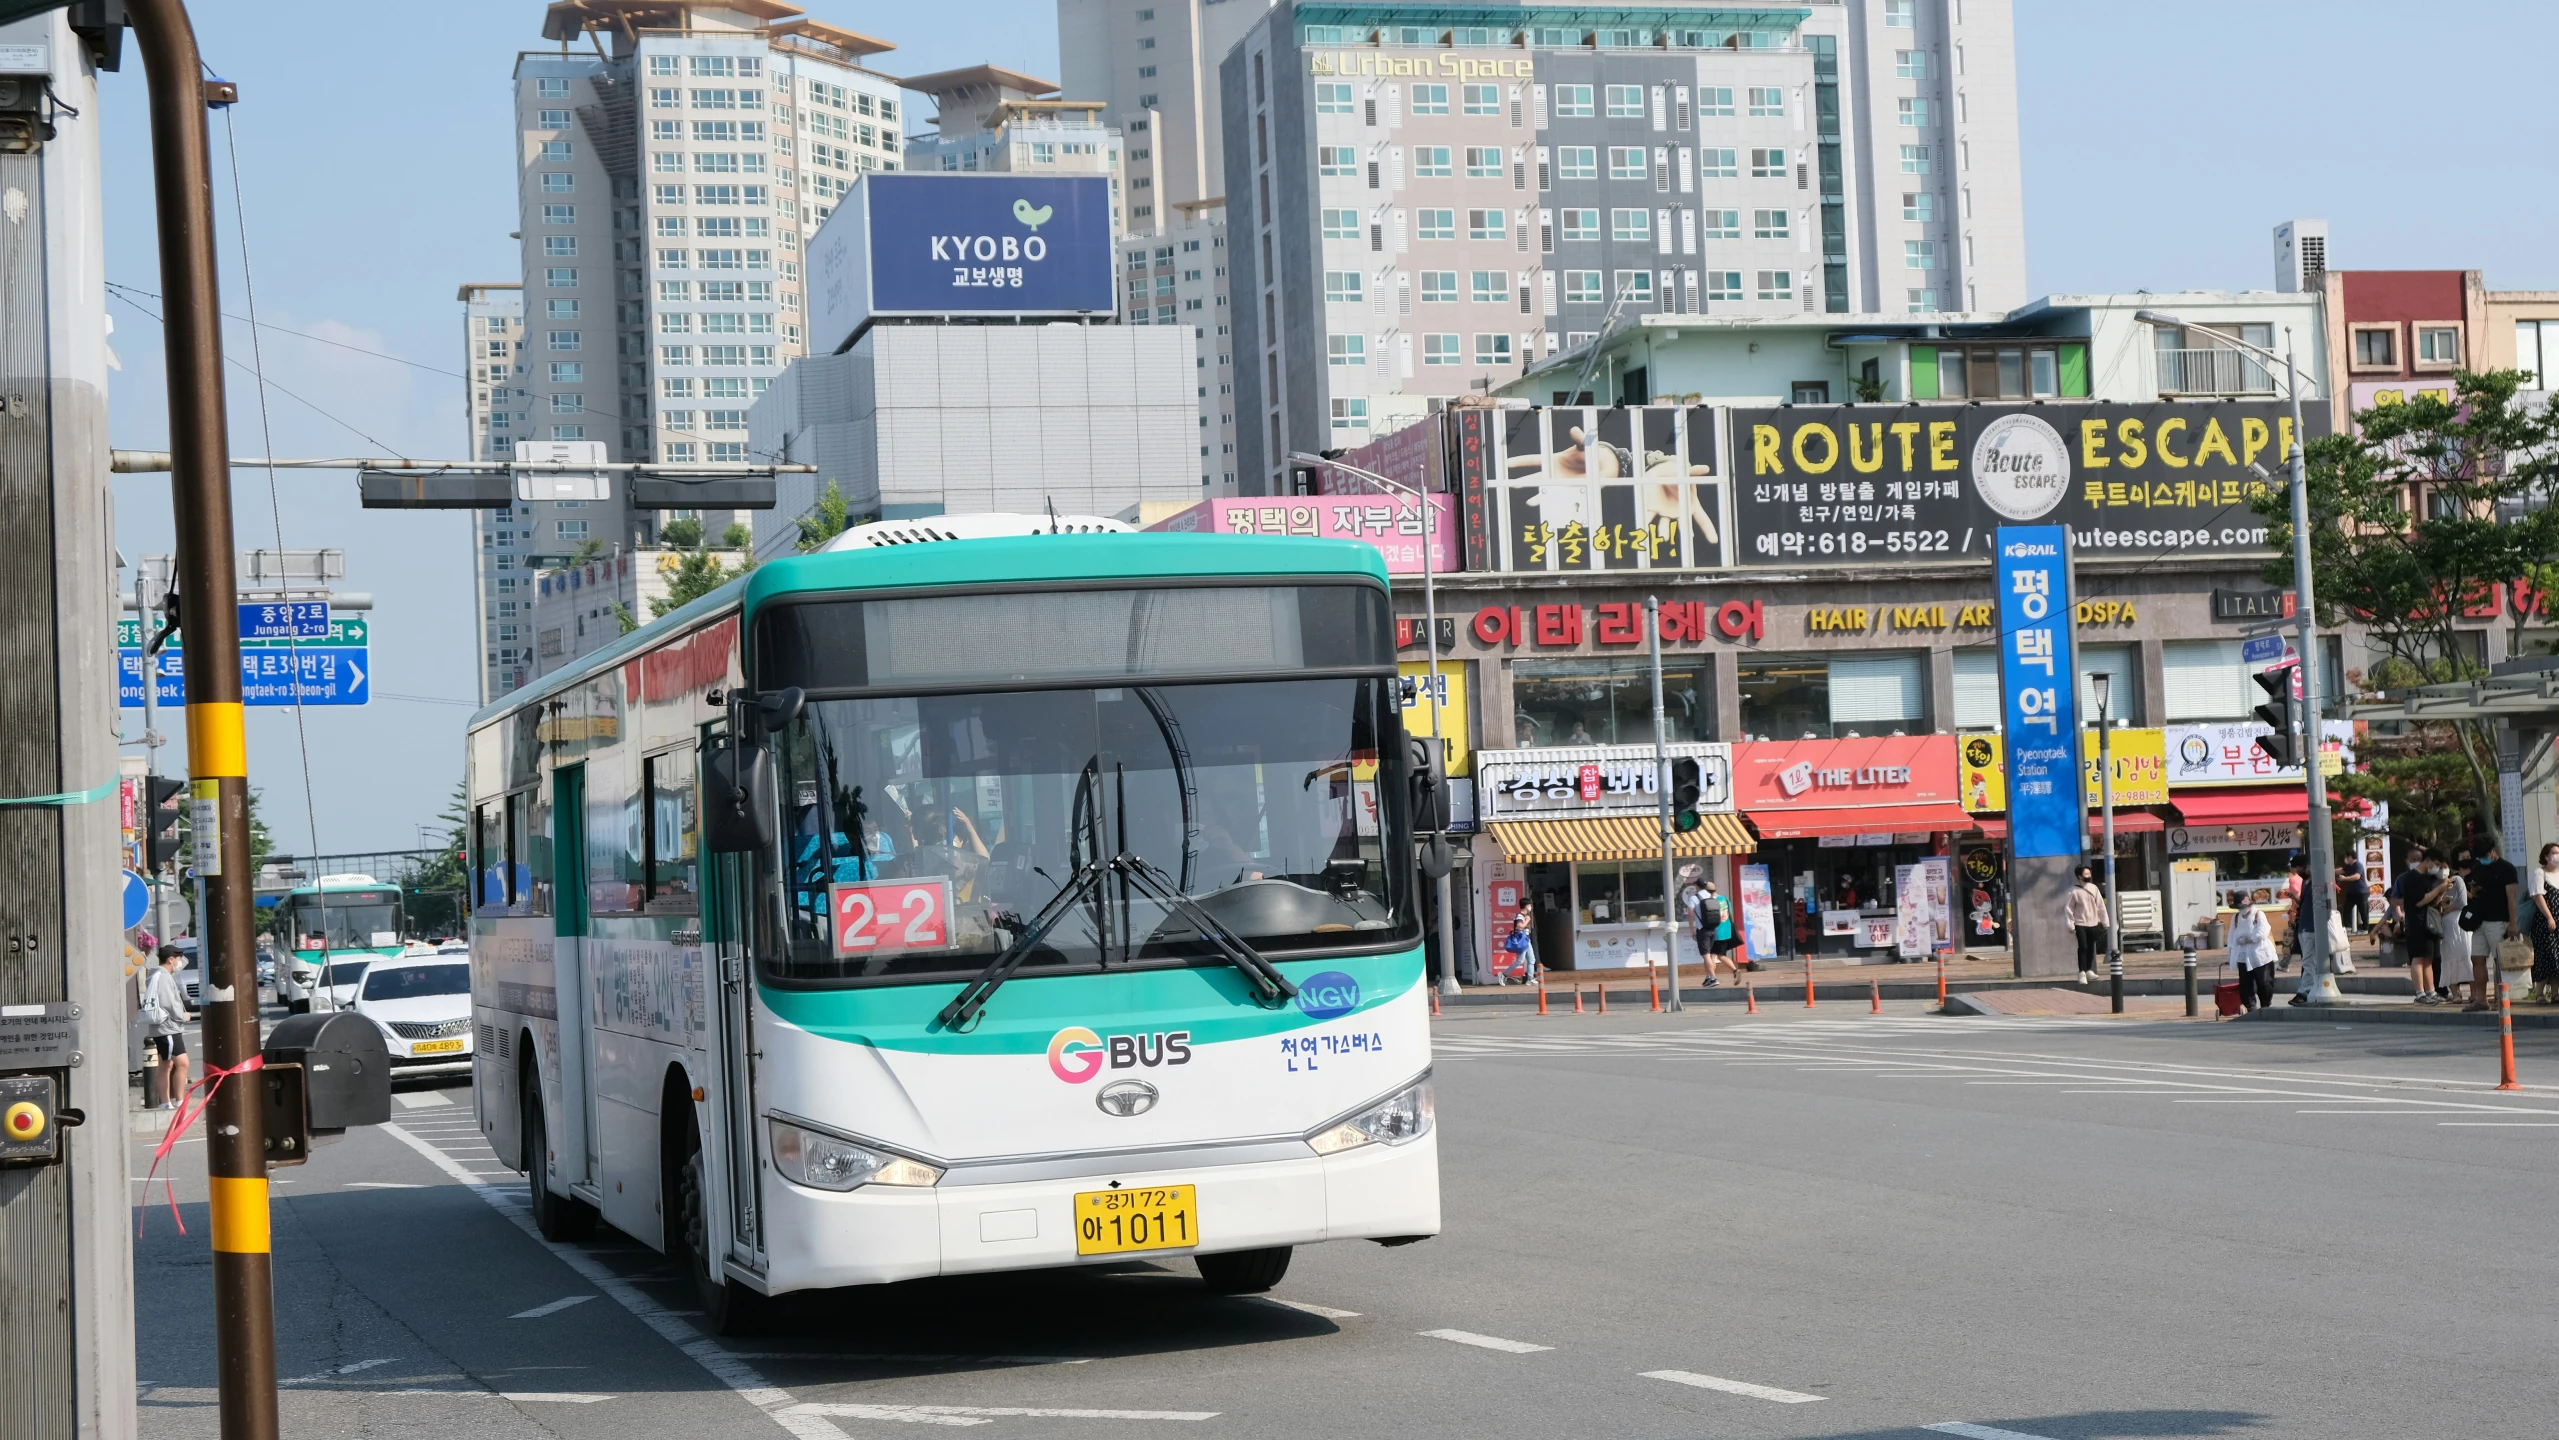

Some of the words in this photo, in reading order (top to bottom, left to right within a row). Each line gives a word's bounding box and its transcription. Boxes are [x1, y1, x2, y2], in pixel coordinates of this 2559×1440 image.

[1339, 52, 1433, 77] Urban
[1439, 53, 1534, 83] Space
[931, 235, 1047, 261] KYOBO
[952, 267, 1023, 287] 교보생명
[1753, 421, 1960, 475] ROUTE
[1984, 448, 2044, 473] Route
[1754, 482, 1808, 502] 신개념
[1820, 480, 1876, 501] 방탈출
[1886, 479, 1960, 500] 게임카페
[2014, 473, 2058, 489] ESCAPE
[1226, 506, 1320, 537] 평택의
[1332, 505, 1436, 537] 자부심!
[1799, 504, 1917, 523] 친구/연인/가족
[1523, 519, 1679, 563] 탈출하라!
[1756, 529, 1950, 557] 예약:618-5522
[2005, 542, 2058, 557] KORAIL
[261, 604, 325, 623] 중앙2로
[1810, 608, 1868, 630] HAIR
[1893, 605, 1949, 628] NAIL
[1959, 604, 1995, 626] AR
[2223, 596, 2281, 615] ITALY
[253, 624, 299, 636] Jungang
[303, 623, 325, 633] 2-ro
[1474, 599, 1765, 646] 이태리헤어
[242, 655, 336, 680] 택로39번길
[2017, 746, 2067, 763] Pyeongtaek
[2221, 742, 2273, 776] 부원
[1815, 768, 1853, 787] THE
[1857, 766, 1912, 785] LITER
[2018, 764, 2048, 777] Station
[1509, 768, 1575, 801] 경성
[841, 889, 937, 948] 2-2
[1868, 924, 1890, 933] TAKE
[309, 941, 323, 949] 9
[1870, 934, 1887, 942] OUT
[1299, 985, 1356, 1008] NGV
[1280, 1032, 1383, 1072] 천연가스버스
[1104, 1193, 1137, 1209] 경기
[1140, 1190, 1167, 1207] 72
[1082, 1216, 1103, 1241] 아
[1109, 1209, 1188, 1246] 1011
